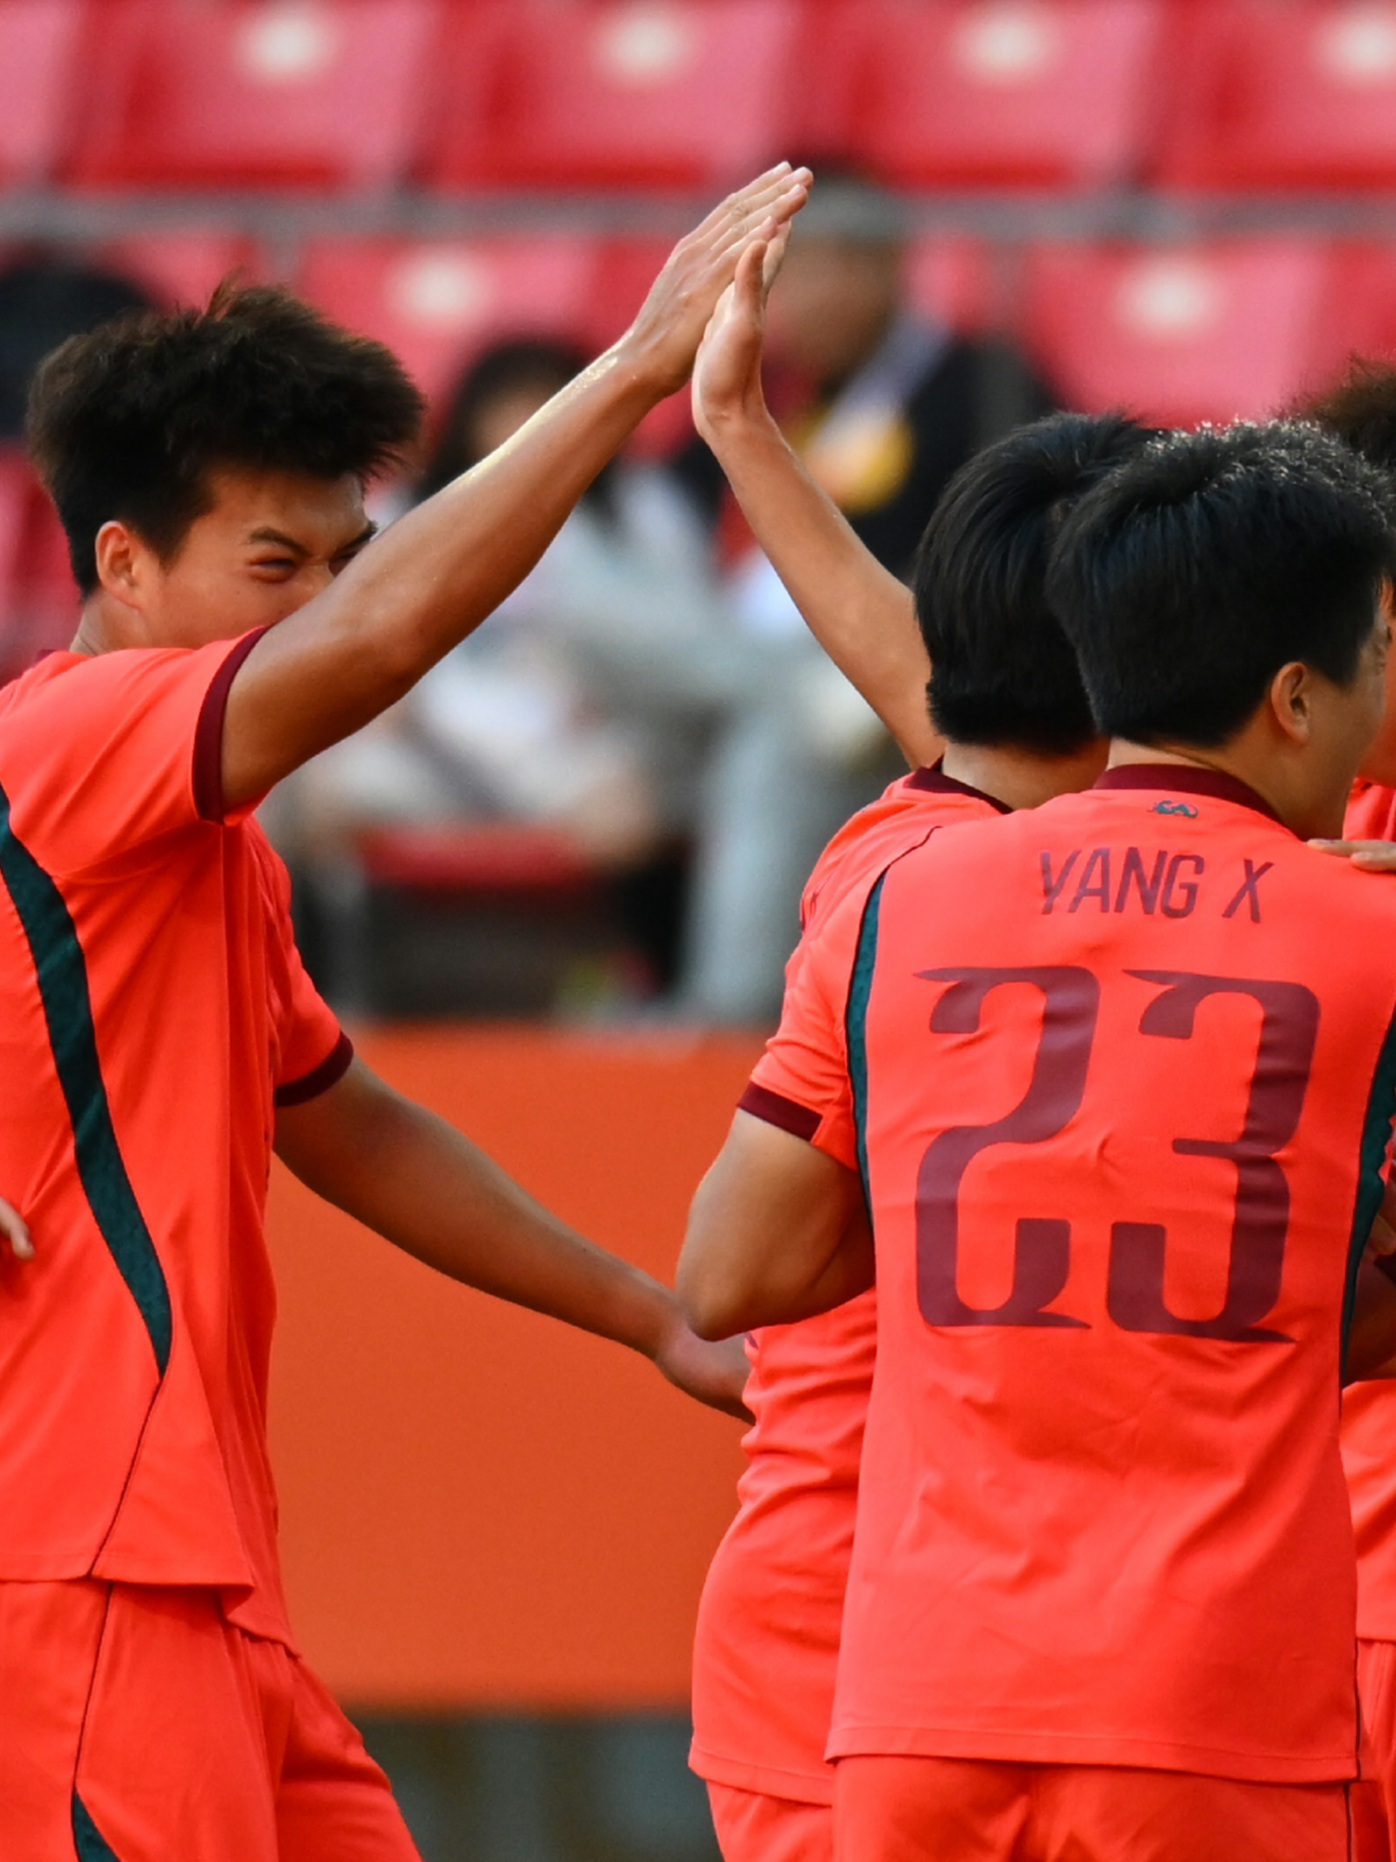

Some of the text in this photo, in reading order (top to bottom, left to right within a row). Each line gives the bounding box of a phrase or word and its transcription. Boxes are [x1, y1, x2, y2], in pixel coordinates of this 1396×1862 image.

[1040, 847, 1274, 923] YANG X
[912, 965, 1321, 1343] 23
